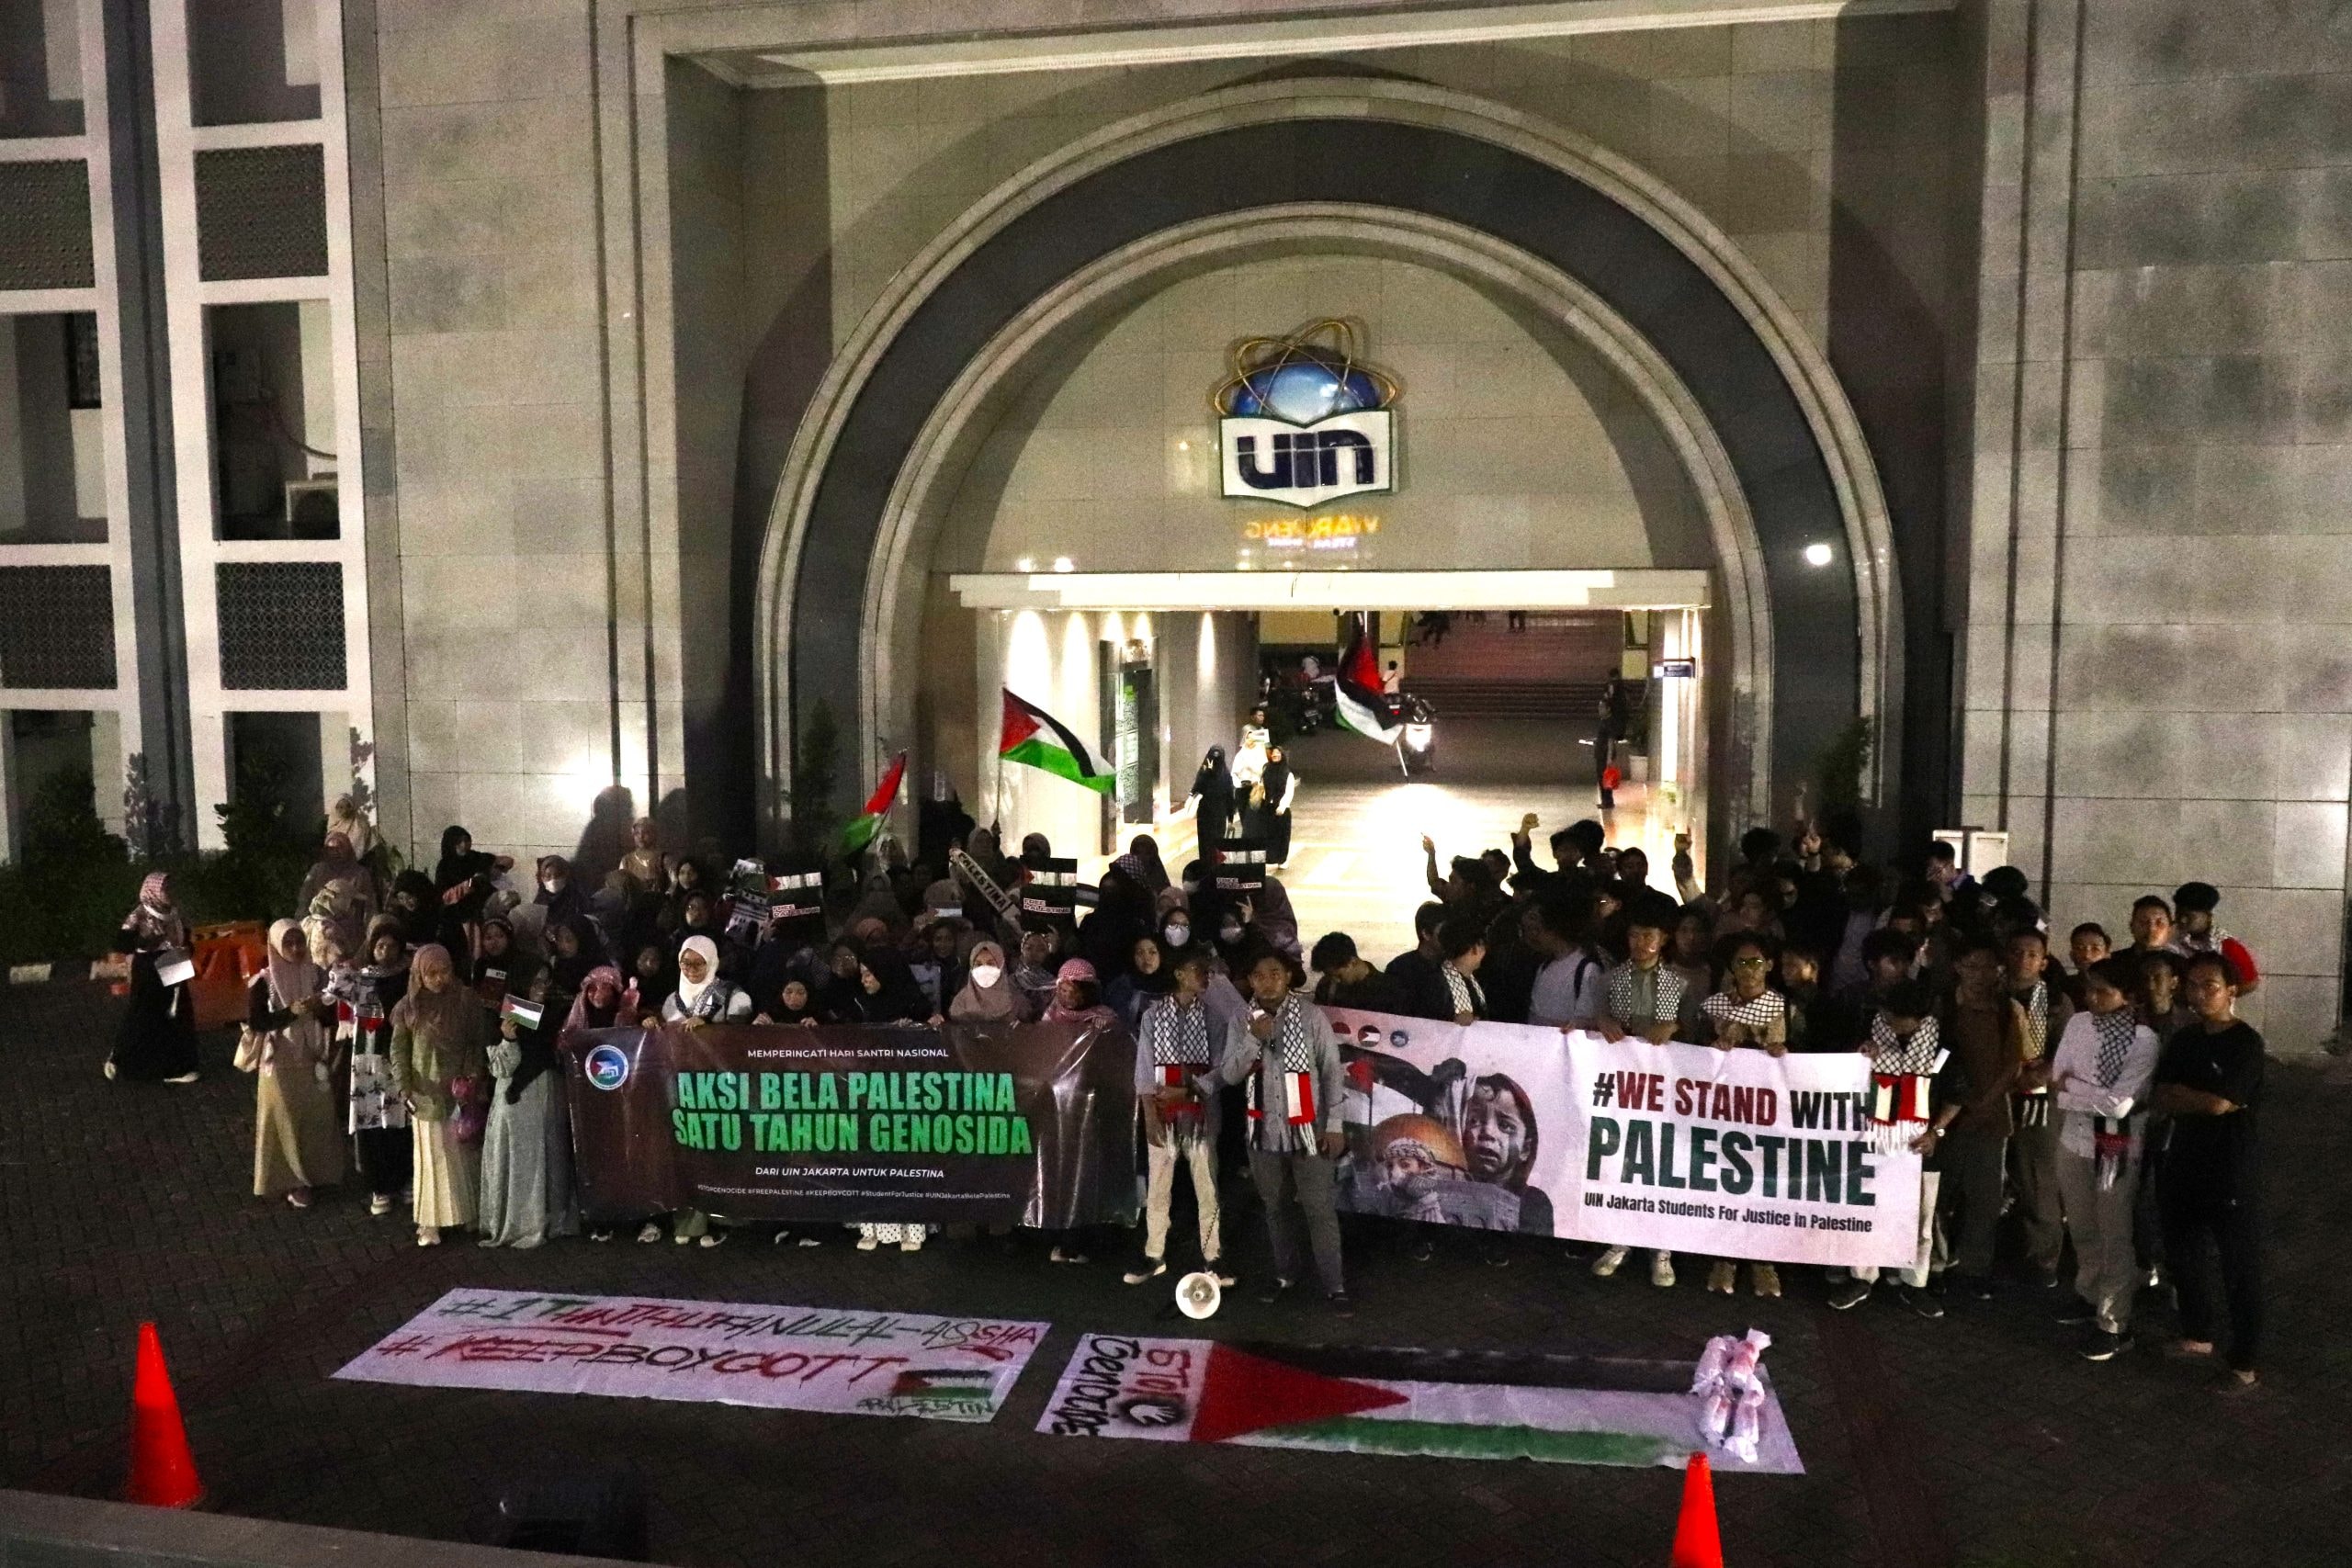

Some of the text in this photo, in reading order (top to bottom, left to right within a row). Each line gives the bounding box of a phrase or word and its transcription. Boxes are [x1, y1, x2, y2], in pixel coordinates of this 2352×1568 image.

[748, 1048, 949, 1058] MEMPERINGATI HARI SANTRI NASIONAL
[676, 1071, 1016, 1112] AKSI BELA PALESTINA
[1592, 1070, 1872, 1132] #WE STAND WITH
[672, 1108, 1033, 1155] SATU TAHUN GENOSIDA
[755, 1167, 944, 1179] DARI UIN JAKARTA UNTUK PALESTINA
[1586, 1115, 1876, 1207] PALESTINE
[1585, 1191, 1872, 1233] UIN Jakarta Students For Justice in Palestine
